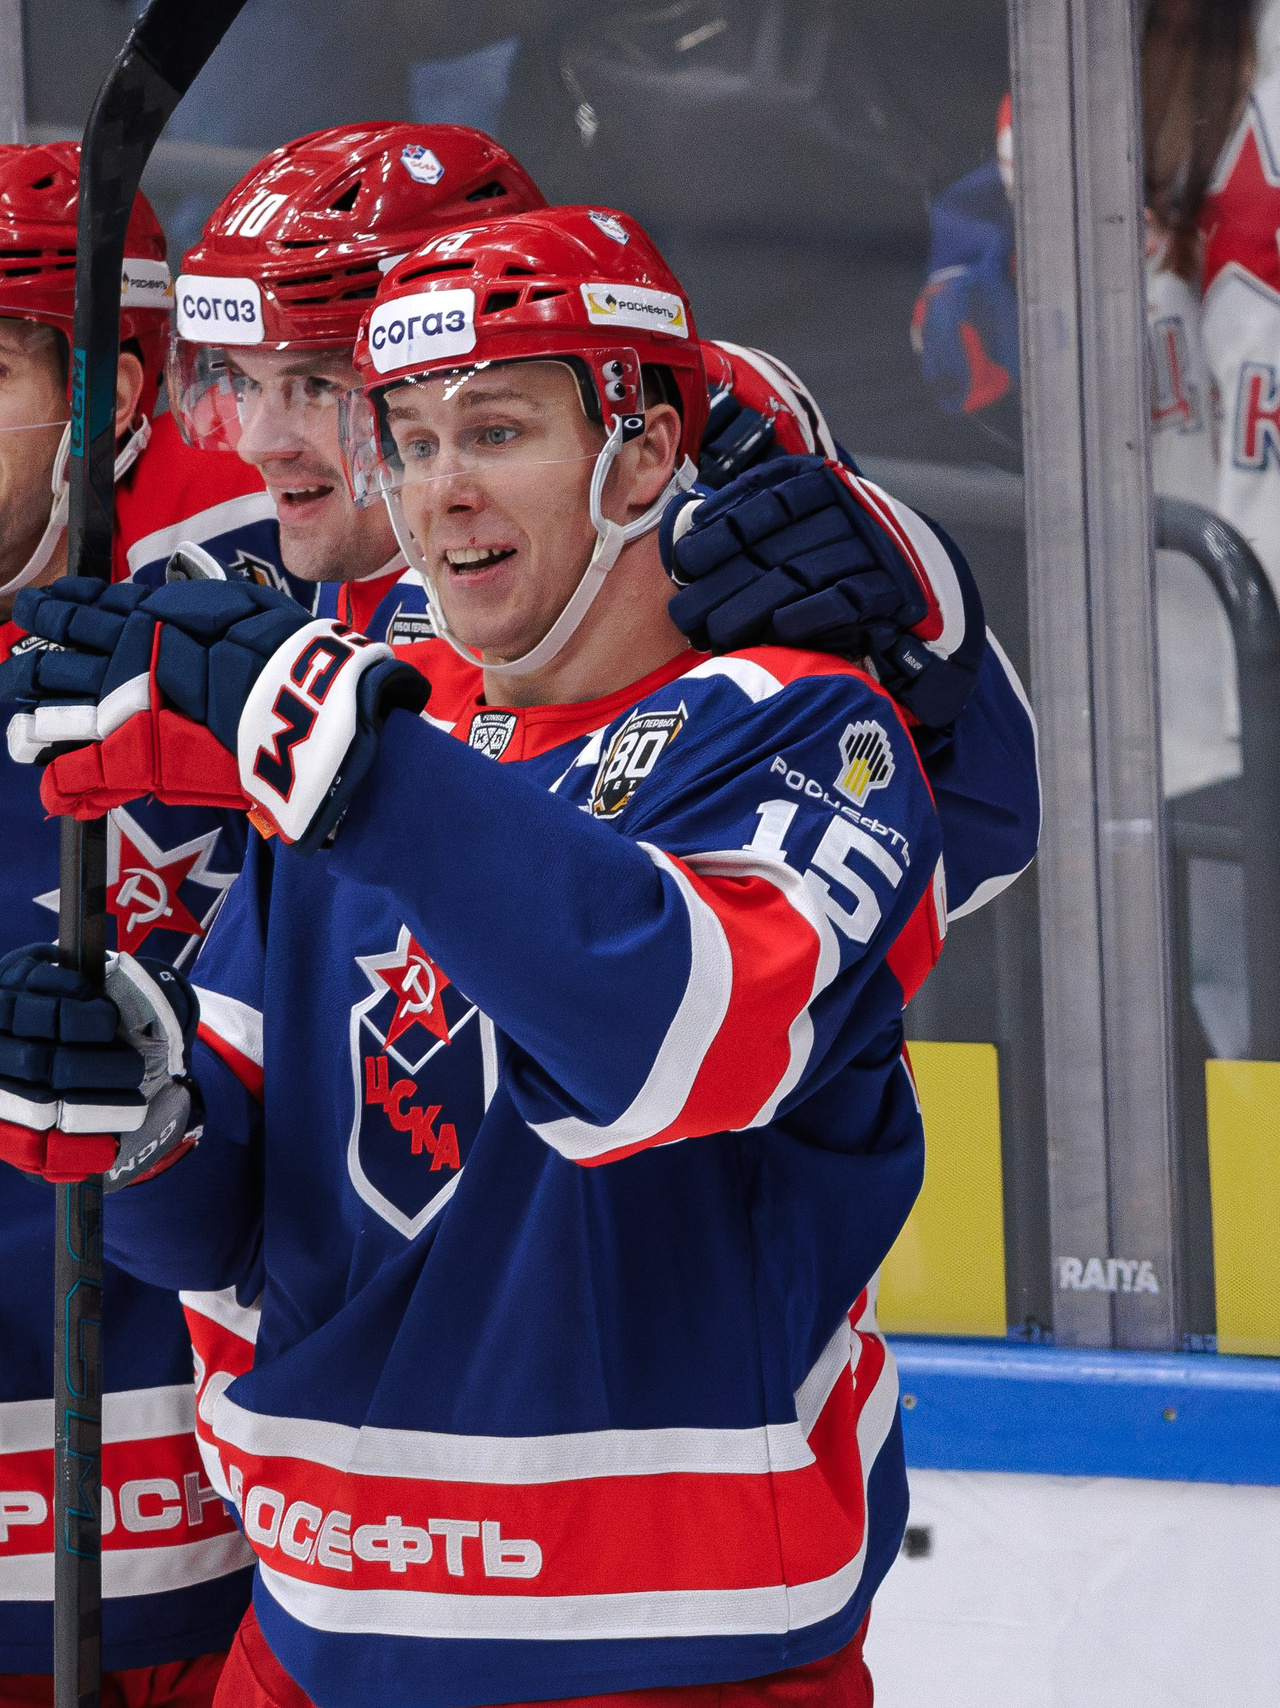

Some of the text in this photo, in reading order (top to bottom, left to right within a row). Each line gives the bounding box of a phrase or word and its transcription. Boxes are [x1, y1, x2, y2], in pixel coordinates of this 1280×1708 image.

[224, 188, 289, 238] 10
[182, 294, 257, 323] согаз
[371, 309, 466, 351] согаз
[618, 300, 675, 319] РОСНЕФТЬ
[604, 730, 669, 784] 80
[741, 798, 904, 945] 15
[364, 1055, 461, 1172] ЦСКА
